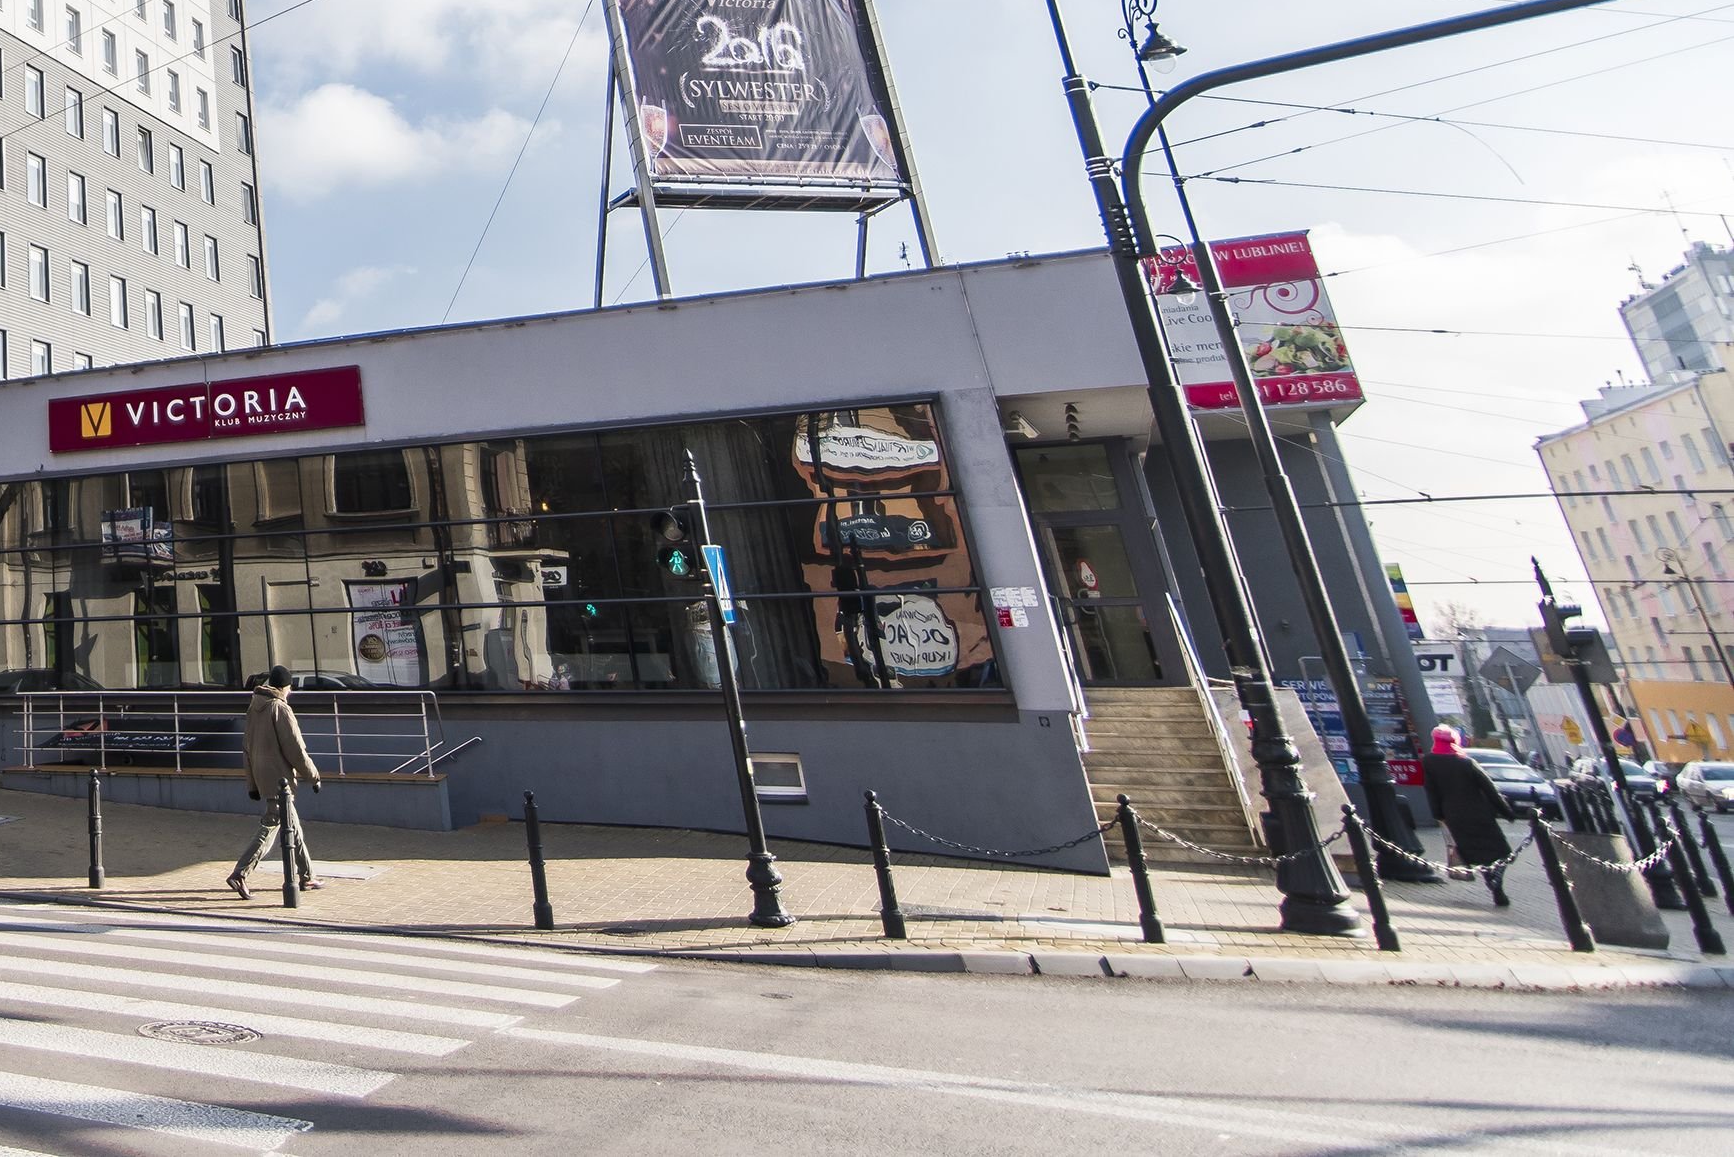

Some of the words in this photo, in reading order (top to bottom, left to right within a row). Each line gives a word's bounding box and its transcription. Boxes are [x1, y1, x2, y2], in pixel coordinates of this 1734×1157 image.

[689, 79, 822, 102] SYLWESTER
[739, 114, 763, 122] START
[764, 114, 785, 122] 20:00
[687, 134, 756, 146] EVENTEAM
[1216, 250, 1229, 261] W
[1232, 241, 1306, 261] LUBLINIE!
[1160, 304, 1199, 315] niadania
[1196, 342, 1223, 352] men
[1219, 391, 1237, 402] tel.
[1276, 382, 1309, 397] 128
[1312, 379, 1347, 395] 586
[125, 385, 308, 426] VICTORIA
[214, 417, 241, 427] KLUB
[248, 410, 307, 424] MUZYCZNY
